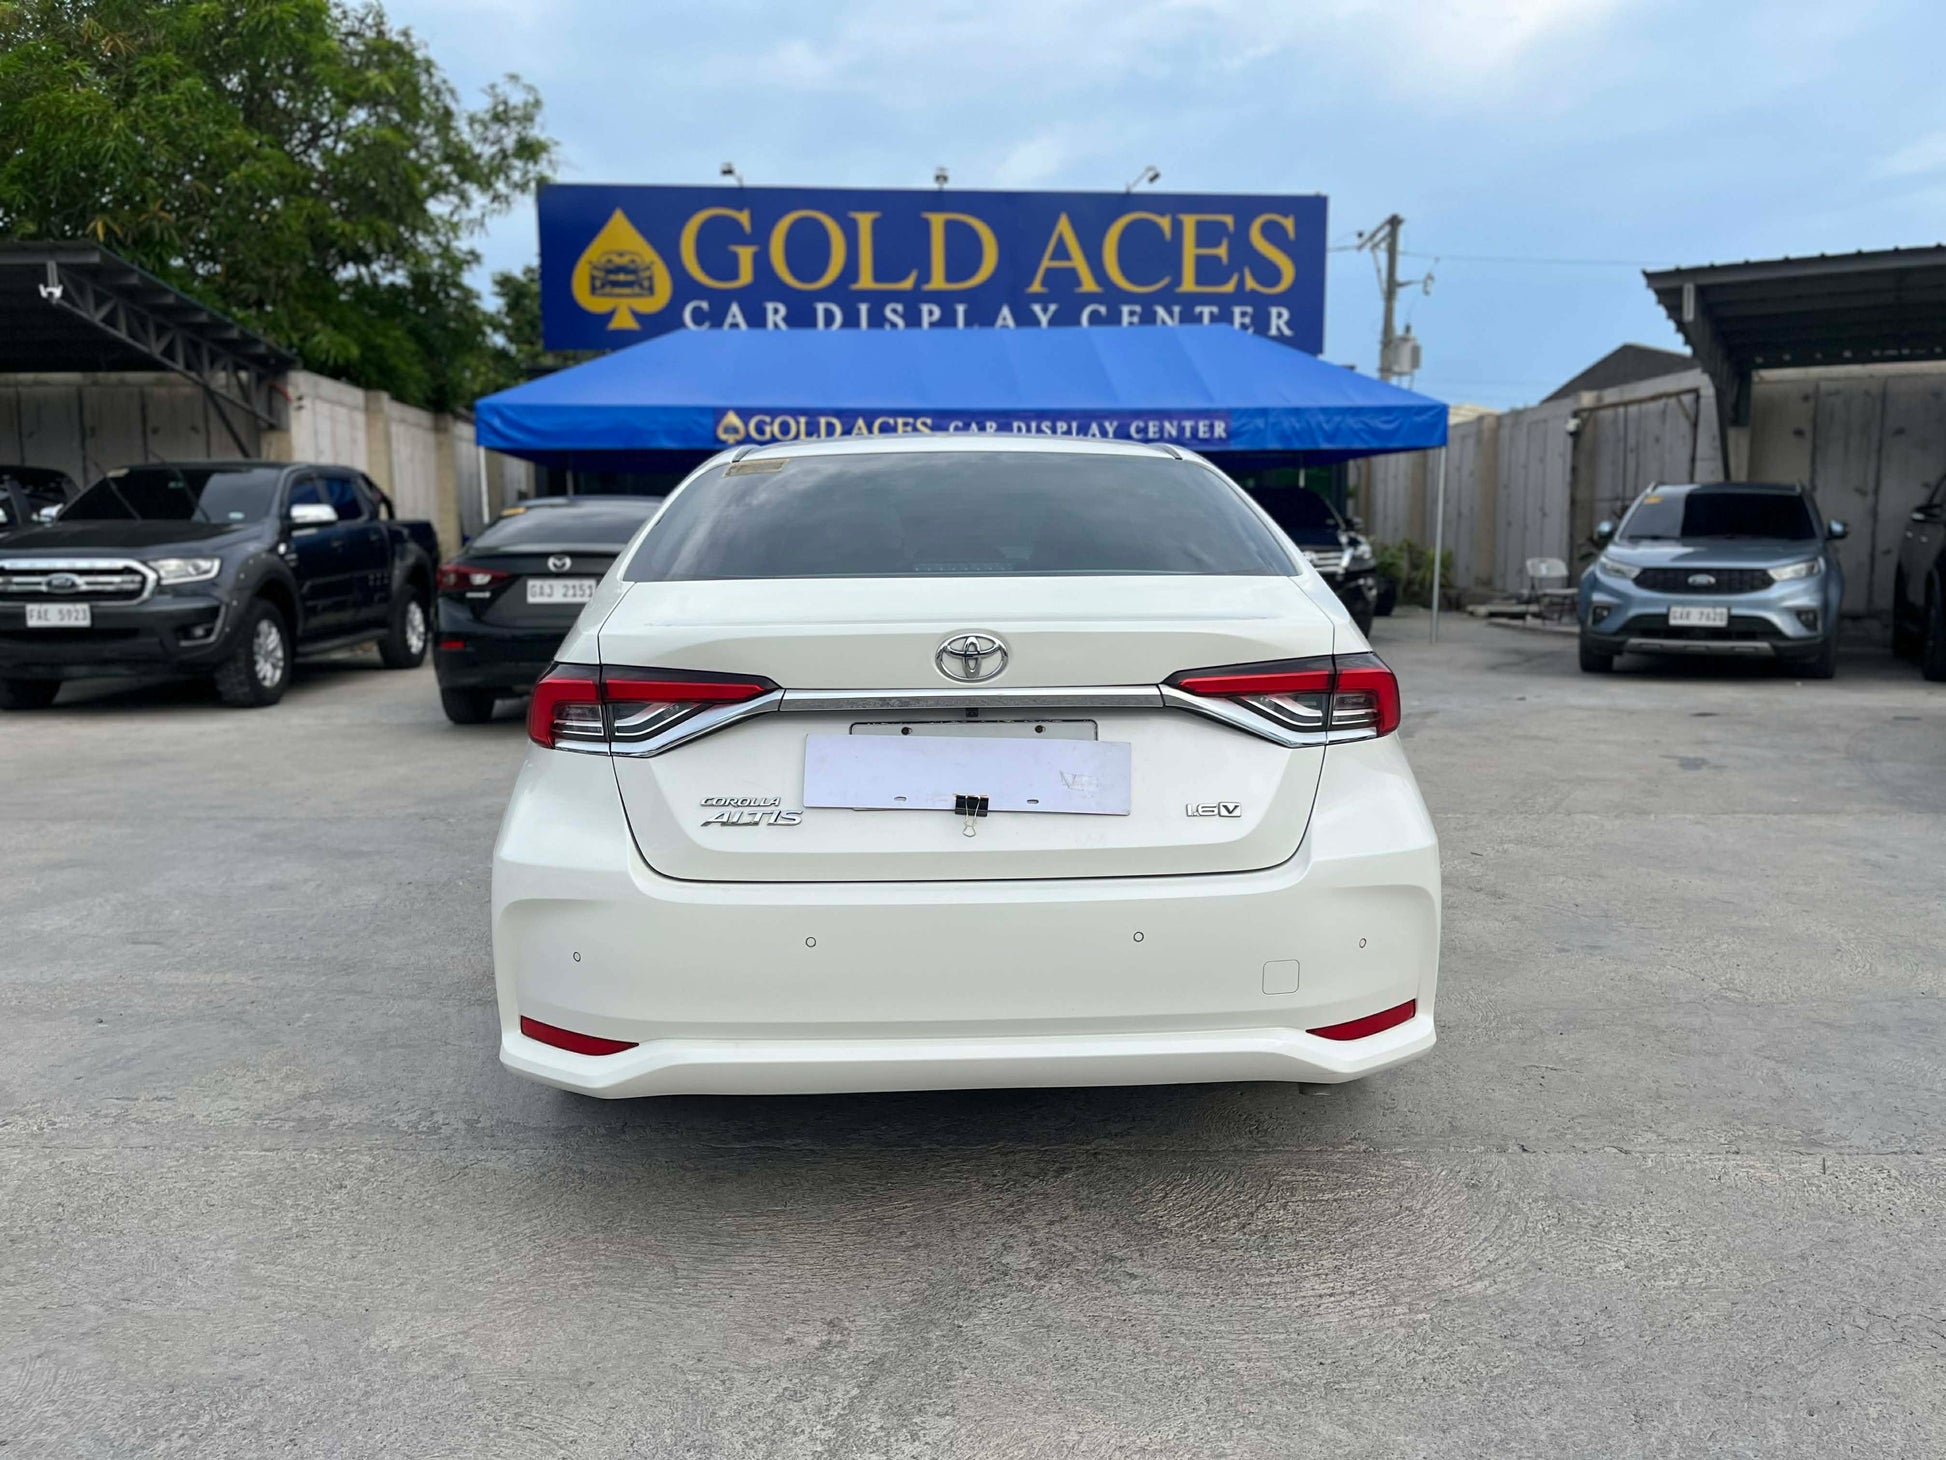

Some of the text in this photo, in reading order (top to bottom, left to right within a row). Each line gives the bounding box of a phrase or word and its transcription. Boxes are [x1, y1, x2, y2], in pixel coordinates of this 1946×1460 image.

[680, 207, 1297, 294] GOLD ACES
[682, 300, 1294, 336] CAR DISPLAY CENTER
[749, 415, 843, 441] GOLD
[852, 416, 933, 434] ACES
[1012, 421, 1119, 438] DISPLAY
[1130, 420, 1228, 439] CENTER
[530, 584, 594, 598] GAJ 2151
[58, 608, 88, 622] 5923
[700, 797, 781, 807] COROLLA
[701, 811, 803, 827] ALTIS
